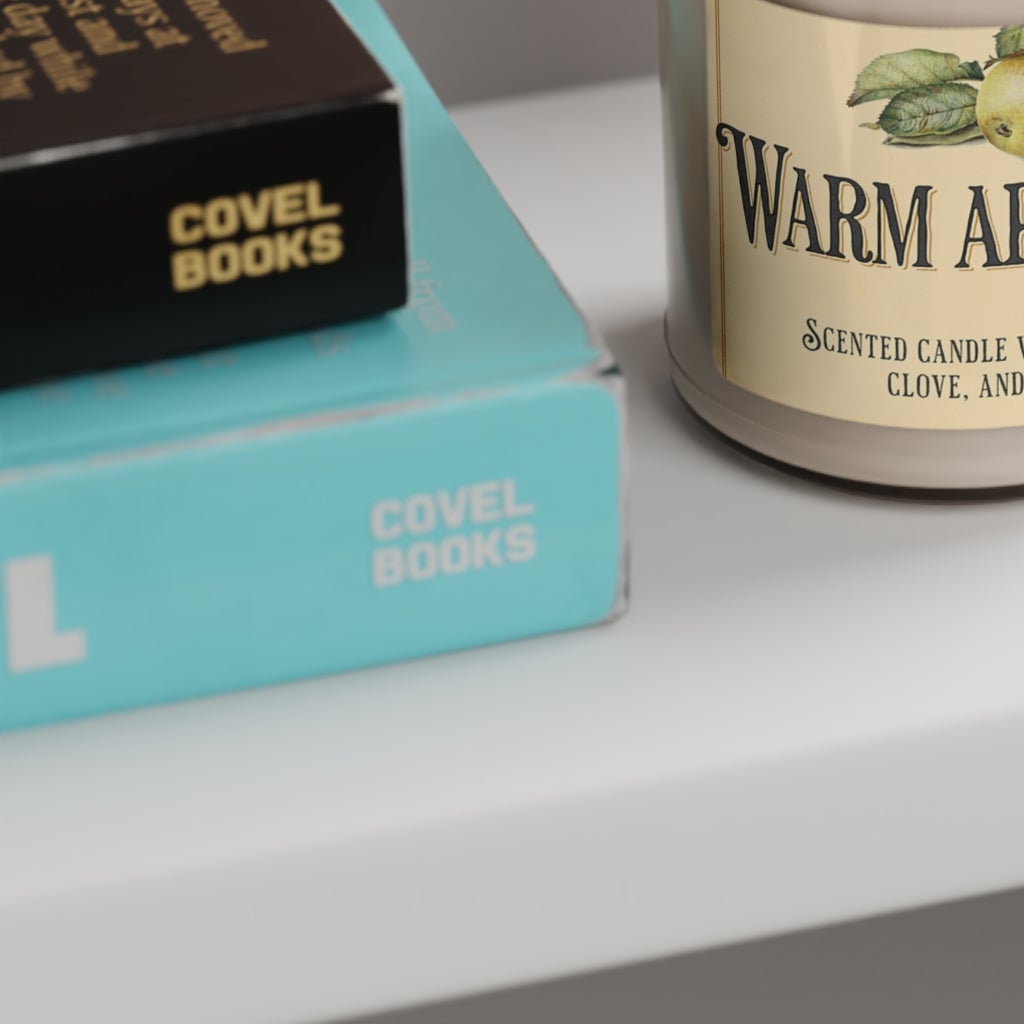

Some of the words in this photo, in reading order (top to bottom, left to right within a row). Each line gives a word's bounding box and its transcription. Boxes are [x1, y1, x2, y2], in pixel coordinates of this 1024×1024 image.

[168, 179, 342, 246] COVEL
[715, 122, 935, 269] WARM
[170, 223, 344, 292] BOOKS
[801, 317, 908, 363] SCENTED
[917, 337, 1009, 364] CANDLE
[887, 371, 970, 402] CLOVE,
[978, 371, 1024, 399] AND
[370, 477, 536, 542] COVEL
[372, 523, 538, 589] BOOKS
